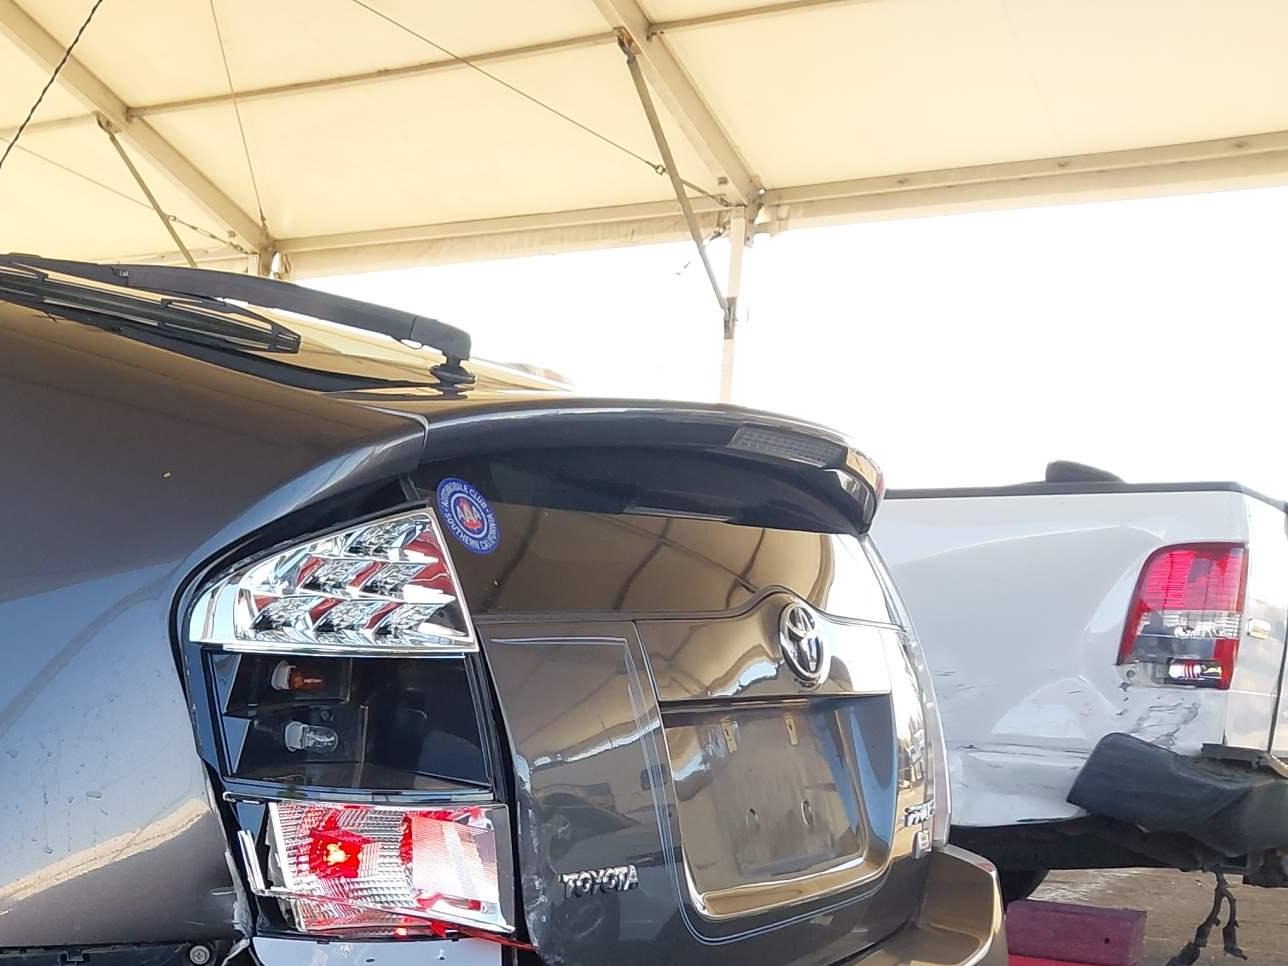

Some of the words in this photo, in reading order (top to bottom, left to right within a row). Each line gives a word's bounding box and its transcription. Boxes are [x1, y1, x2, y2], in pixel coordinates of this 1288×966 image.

[456, 502, 482, 523] AAA
[469, 488, 488, 510] CLUB
[444, 512, 480, 550] SOUTHERN
[558, 864, 639, 898] TOYOTA
